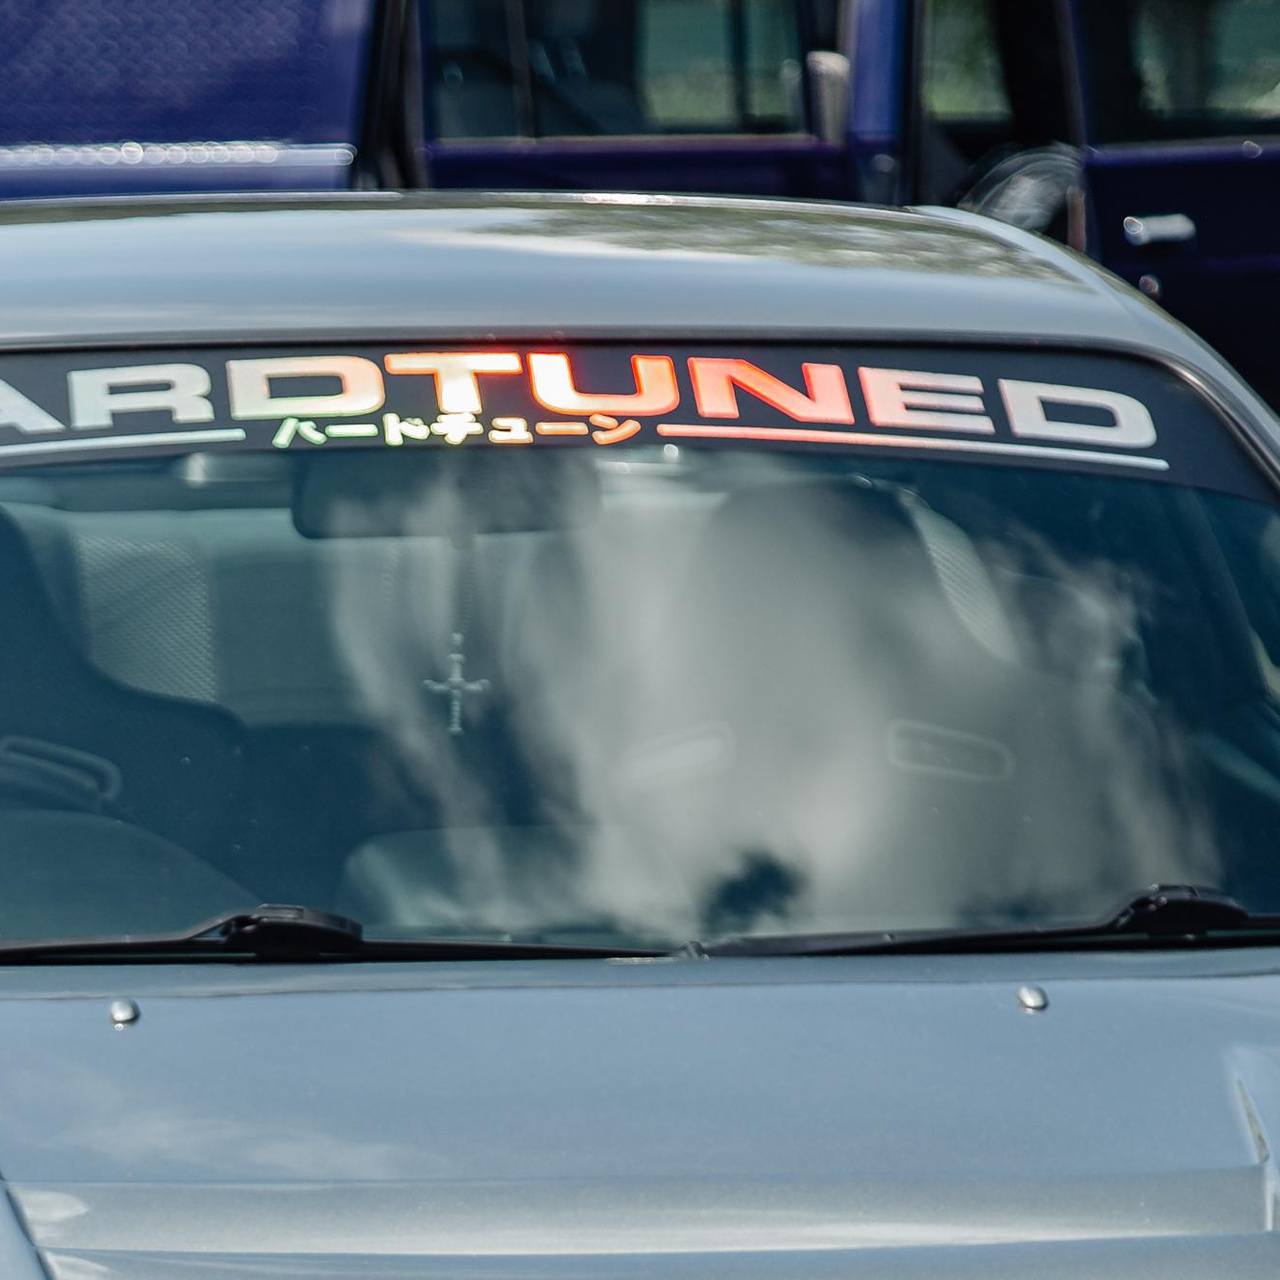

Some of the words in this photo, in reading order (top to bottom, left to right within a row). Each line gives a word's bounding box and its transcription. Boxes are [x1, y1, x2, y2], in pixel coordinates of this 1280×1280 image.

[271, 412, 641, 449] ハードチューン
